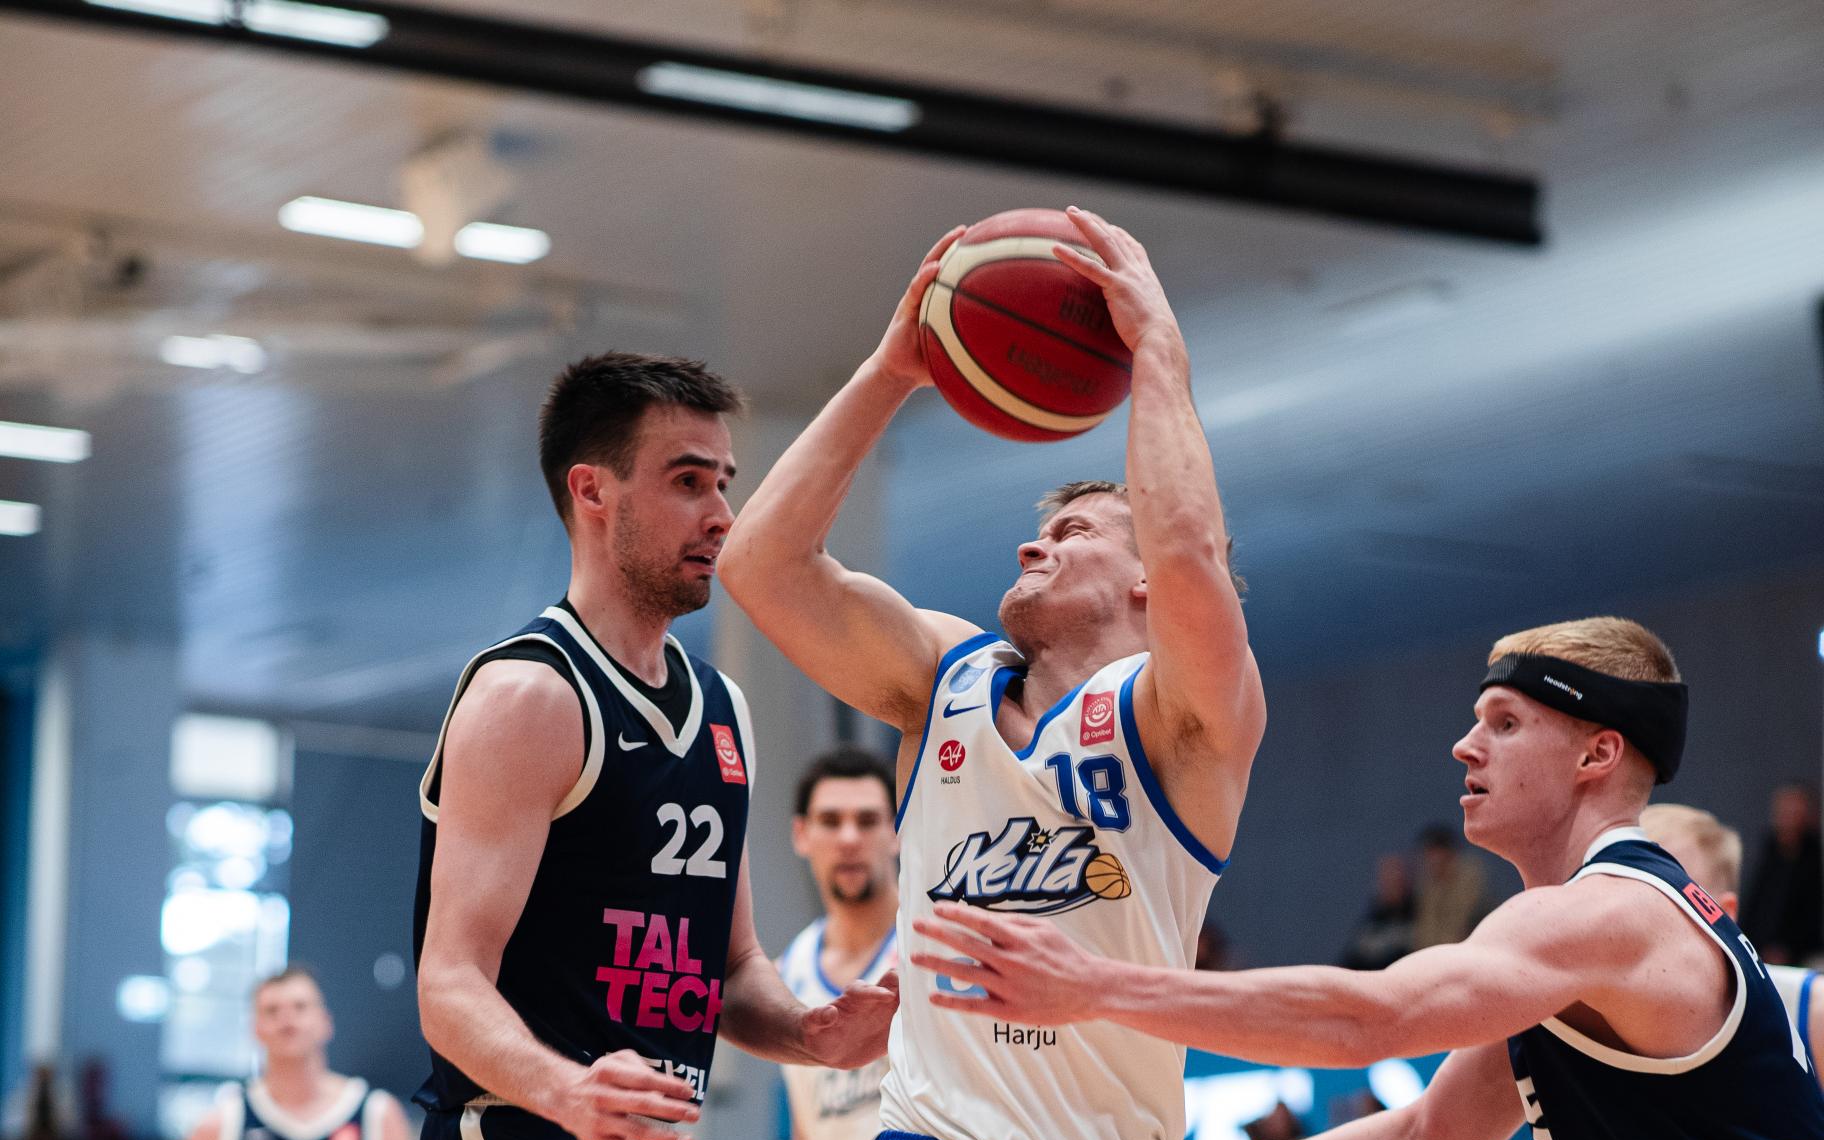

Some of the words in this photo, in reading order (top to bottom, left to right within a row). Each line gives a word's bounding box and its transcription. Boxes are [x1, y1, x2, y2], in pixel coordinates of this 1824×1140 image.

[1543, 674, 1583, 701] Headstrong
[940, 775, 961, 785] HALDUS
[1045, 752, 1131, 833] 18
[651, 802, 727, 879] 22
[926, 816, 1100, 905] Keila
[603, 907, 703, 975] TAL
[993, 1023, 1057, 1050] Harju
